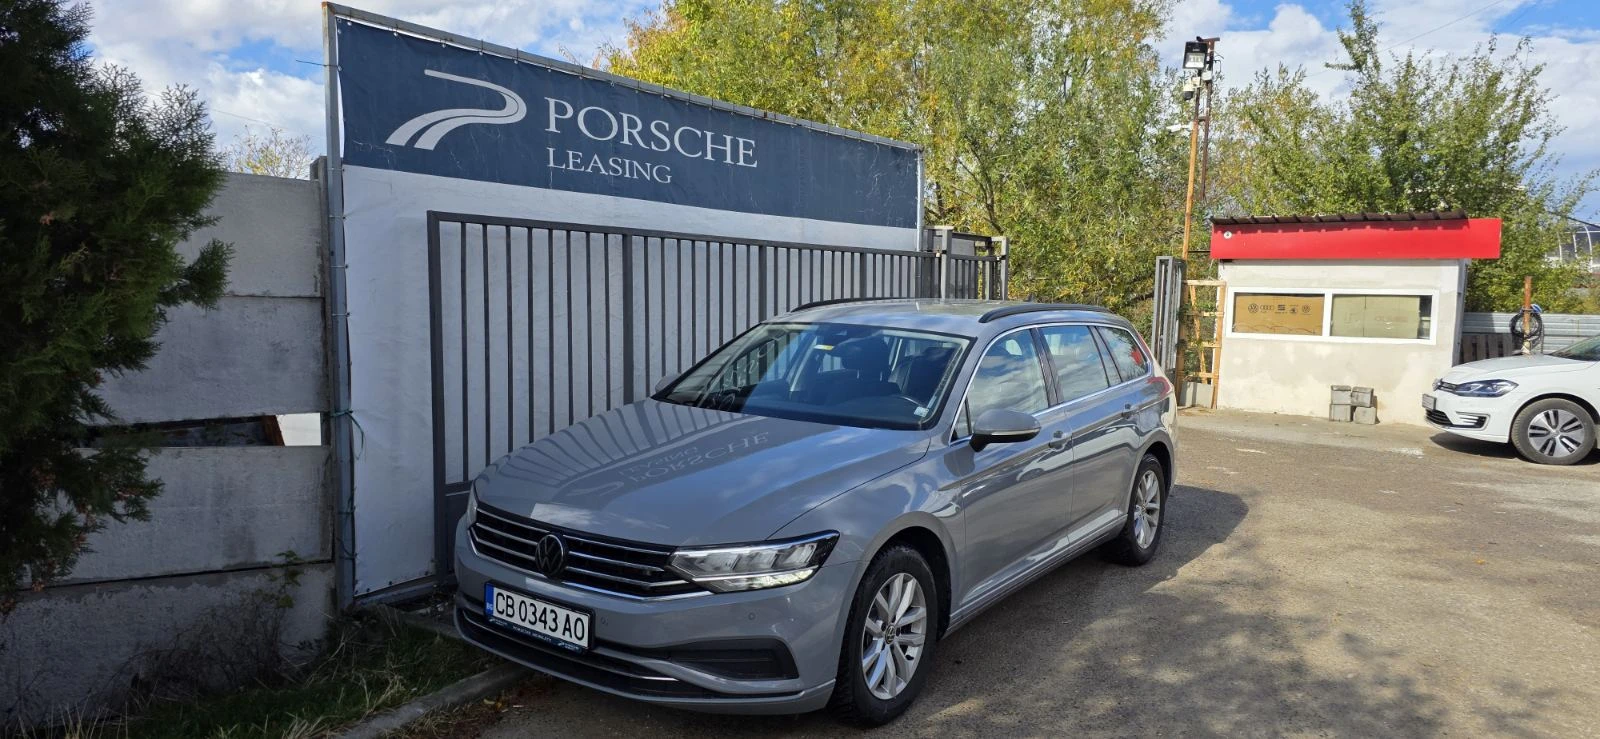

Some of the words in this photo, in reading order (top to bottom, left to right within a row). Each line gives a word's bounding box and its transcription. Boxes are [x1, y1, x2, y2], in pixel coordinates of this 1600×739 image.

[545, 97, 758, 168] PORSCHE
[547, 148, 672, 184] LEASING
[495, 592, 515, 618] CB
[518, 600, 558, 632] 0343
[562, 613, 585, 641] AO
